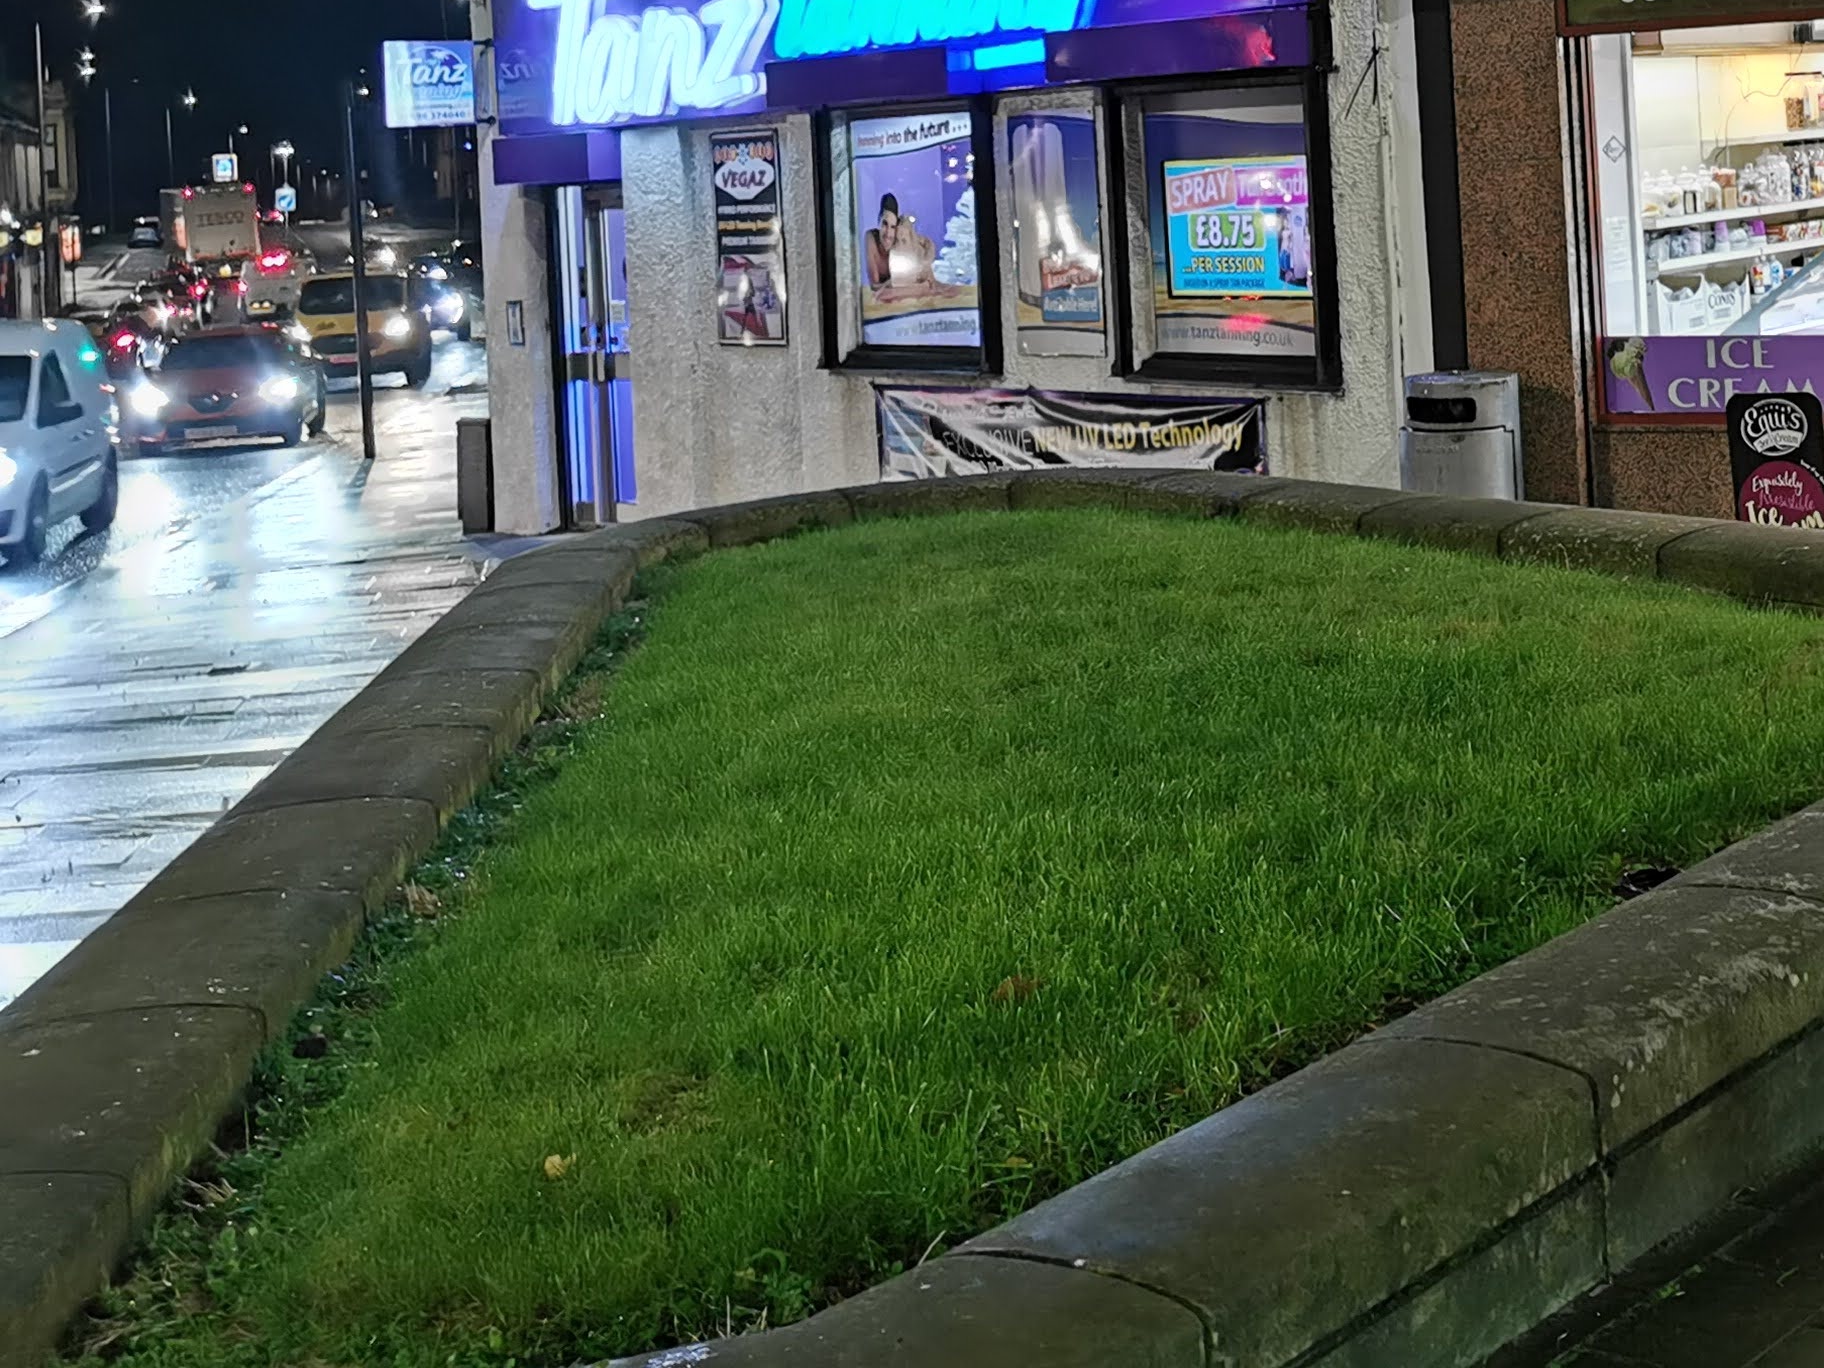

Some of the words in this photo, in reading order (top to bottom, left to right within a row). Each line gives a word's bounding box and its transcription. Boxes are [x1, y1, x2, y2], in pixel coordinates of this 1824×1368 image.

[396, 57, 467, 85] Tanz
[885, 129, 902, 145] into
[903, 125, 918, 143] the
[722, 169, 767, 189] VEGAZ
[1171, 171, 1230, 209] SPRAY
[195, 211, 245, 228] TESCO
[1195, 214, 1256, 249] £8.75
[1215, 256, 1265, 274] SESSION
[1161, 326, 1294, 347] www.tanztanning.co.uk
[1706, 338, 1775, 369] ICE
[1034, 425, 1072, 453] NEW
[1076, 424, 1099, 451] UV
[1103, 421, 1137, 450] LED
[1141, 418, 1243, 452] Technology
[1744, 405, 1802, 441] Equi's
[1745, 499, 1784, 527] Ice
